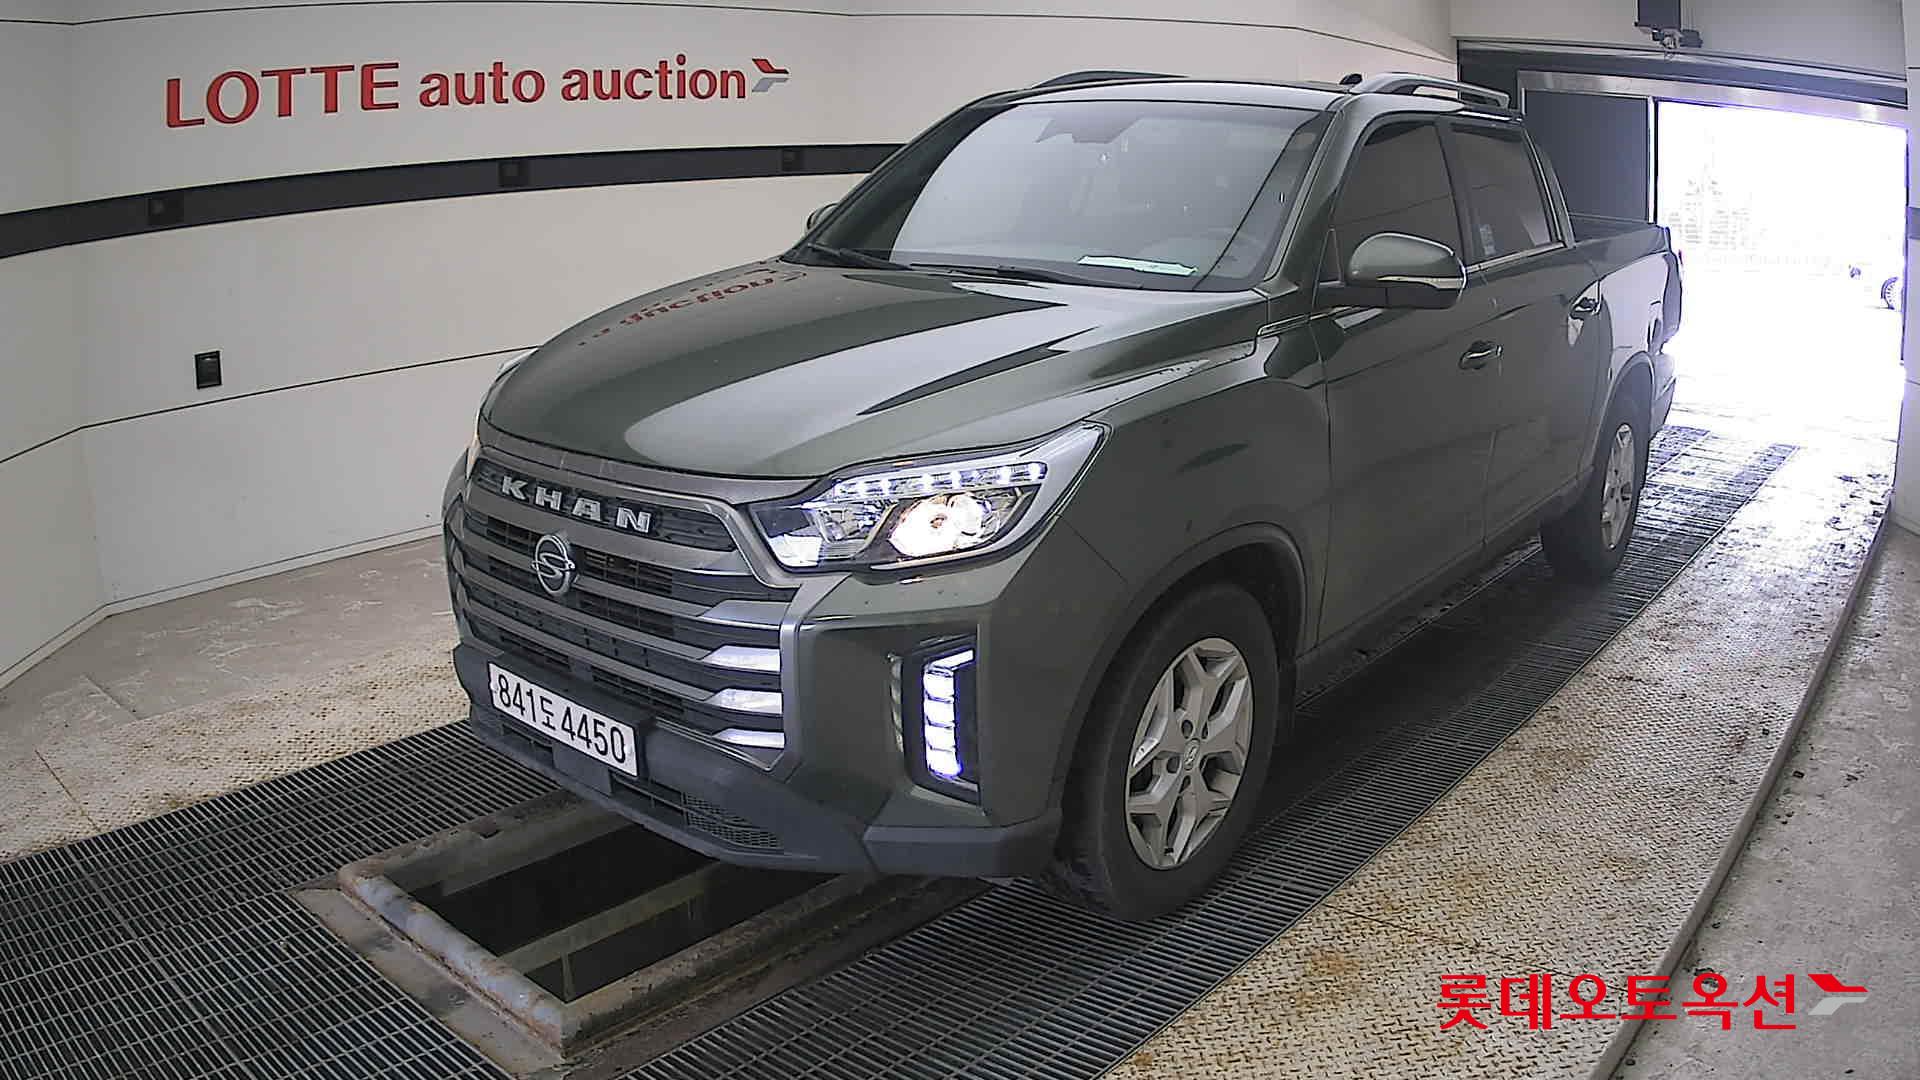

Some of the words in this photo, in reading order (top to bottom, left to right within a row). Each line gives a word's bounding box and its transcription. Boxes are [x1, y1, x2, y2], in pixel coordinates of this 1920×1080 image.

[166, 62, 399, 128] LOTTE
[419, 61, 546, 107] auto
[560, 53, 747, 101] auction
[502, 476, 652, 533] KHAN
